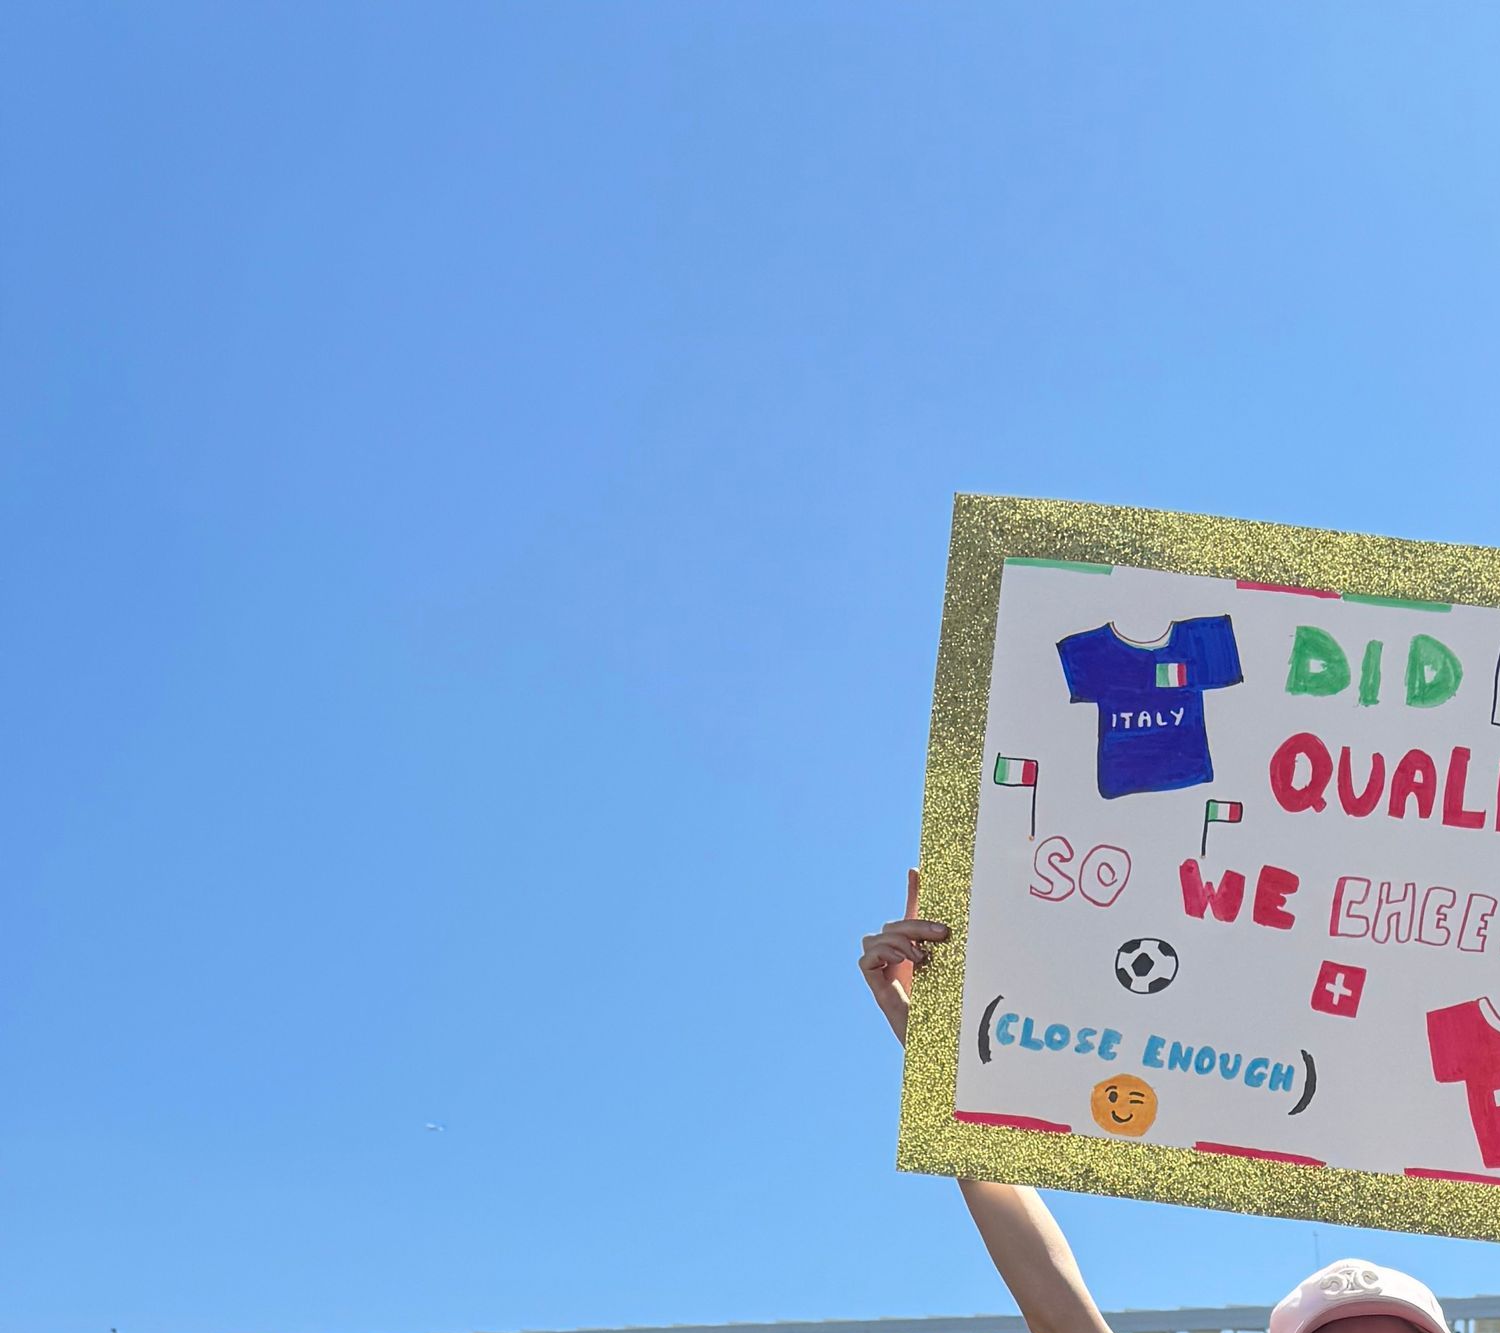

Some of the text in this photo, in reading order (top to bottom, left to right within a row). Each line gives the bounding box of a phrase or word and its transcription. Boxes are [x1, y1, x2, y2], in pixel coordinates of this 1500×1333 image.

[1285, 623, 1465, 708] DID
[1110, 704, 1186, 731] ITALY
[1029, 835, 1132, 908] SO
[1179, 857, 1301, 931] WE
